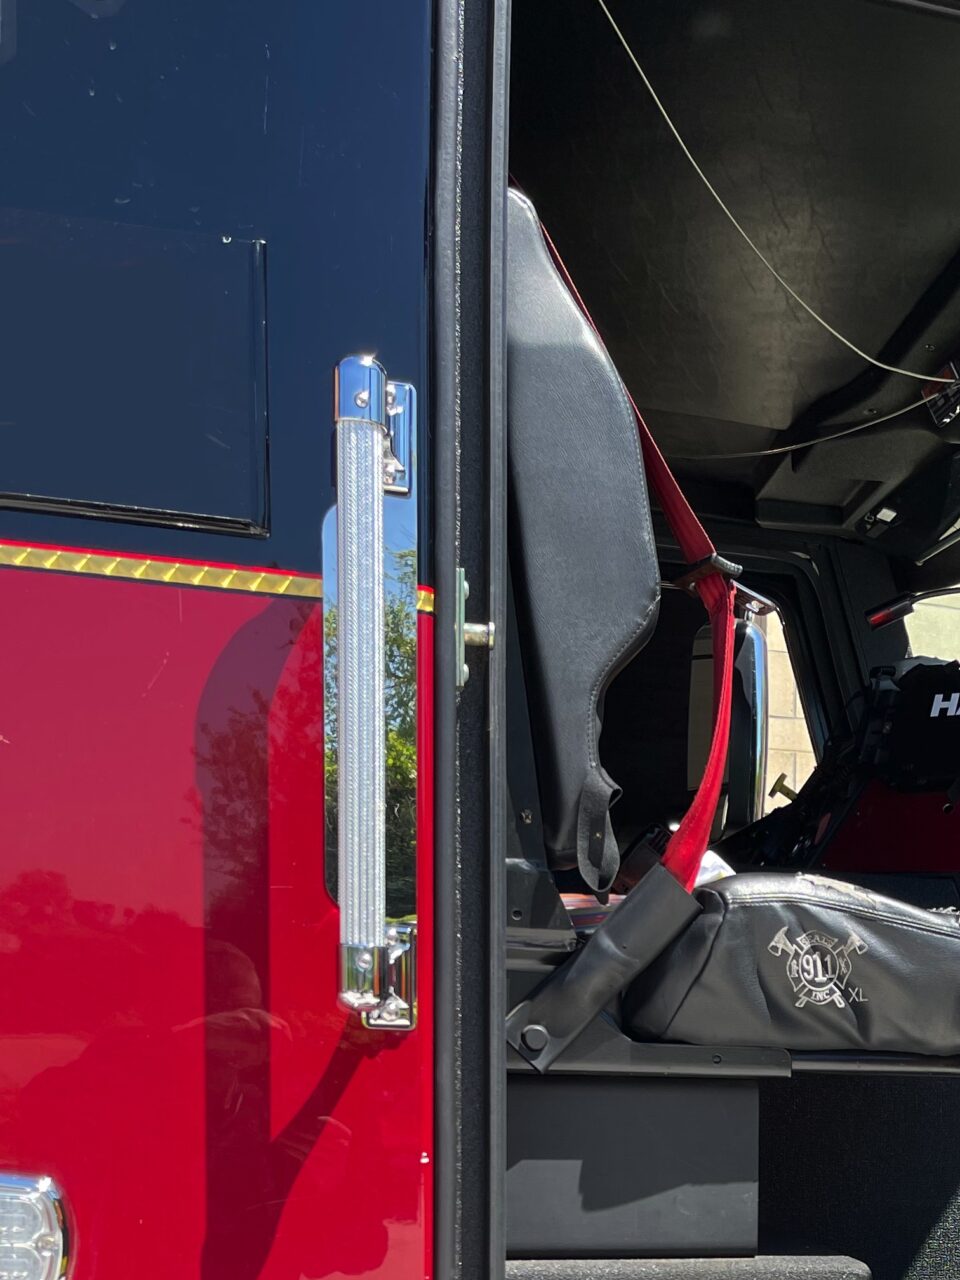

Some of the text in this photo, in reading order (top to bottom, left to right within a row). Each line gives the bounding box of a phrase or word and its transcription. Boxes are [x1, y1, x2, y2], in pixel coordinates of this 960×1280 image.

[802, 951, 836, 983] 911
[811, 990, 831, 1002] INC
[848, 987, 869, 1003] XL
